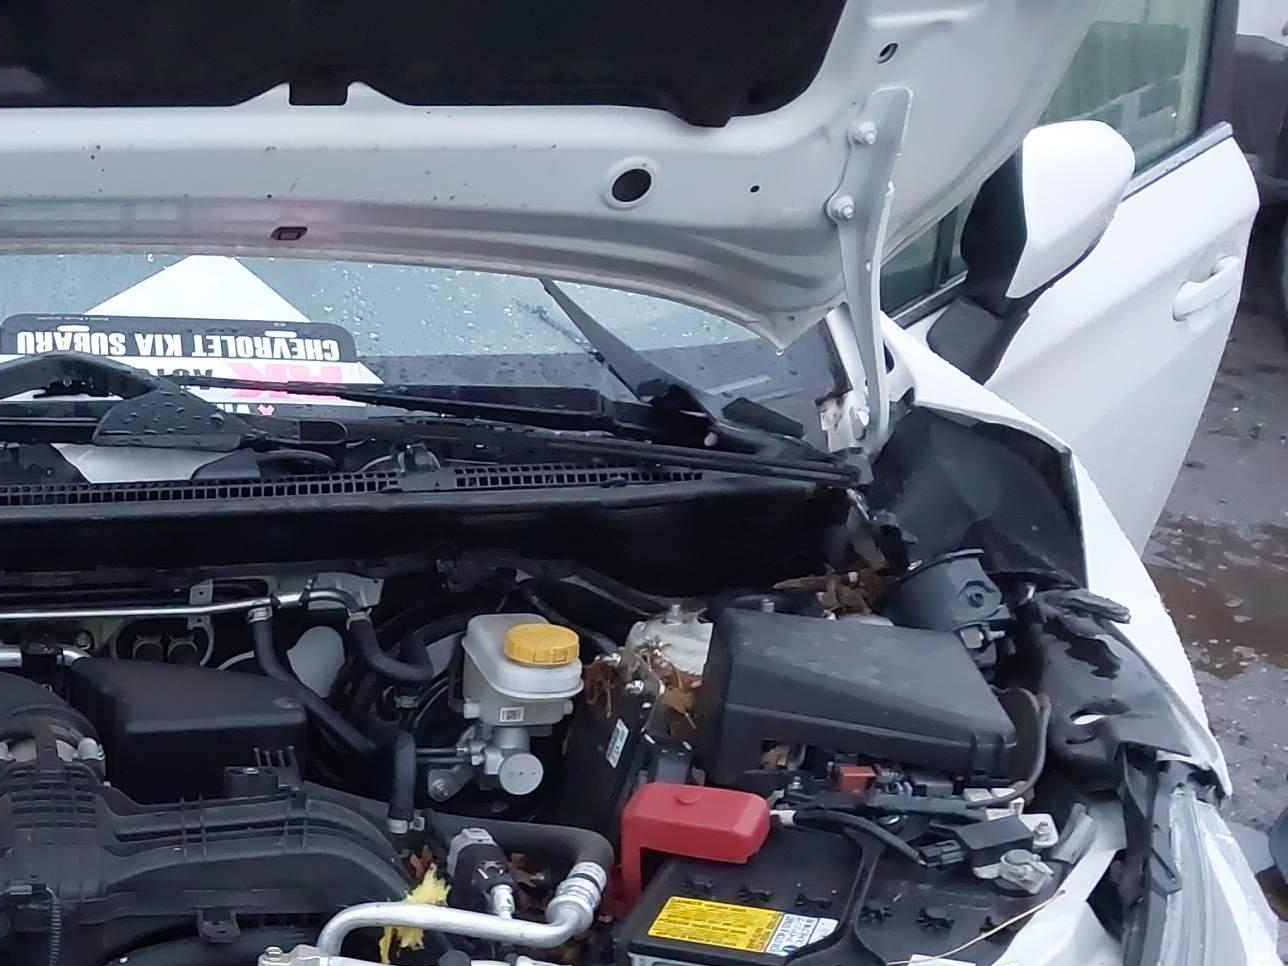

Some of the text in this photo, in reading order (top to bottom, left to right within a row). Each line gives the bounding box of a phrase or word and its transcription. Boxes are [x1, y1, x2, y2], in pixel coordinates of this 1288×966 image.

[16, 330, 341, 361] CHEVROLET KIA SUBARU
